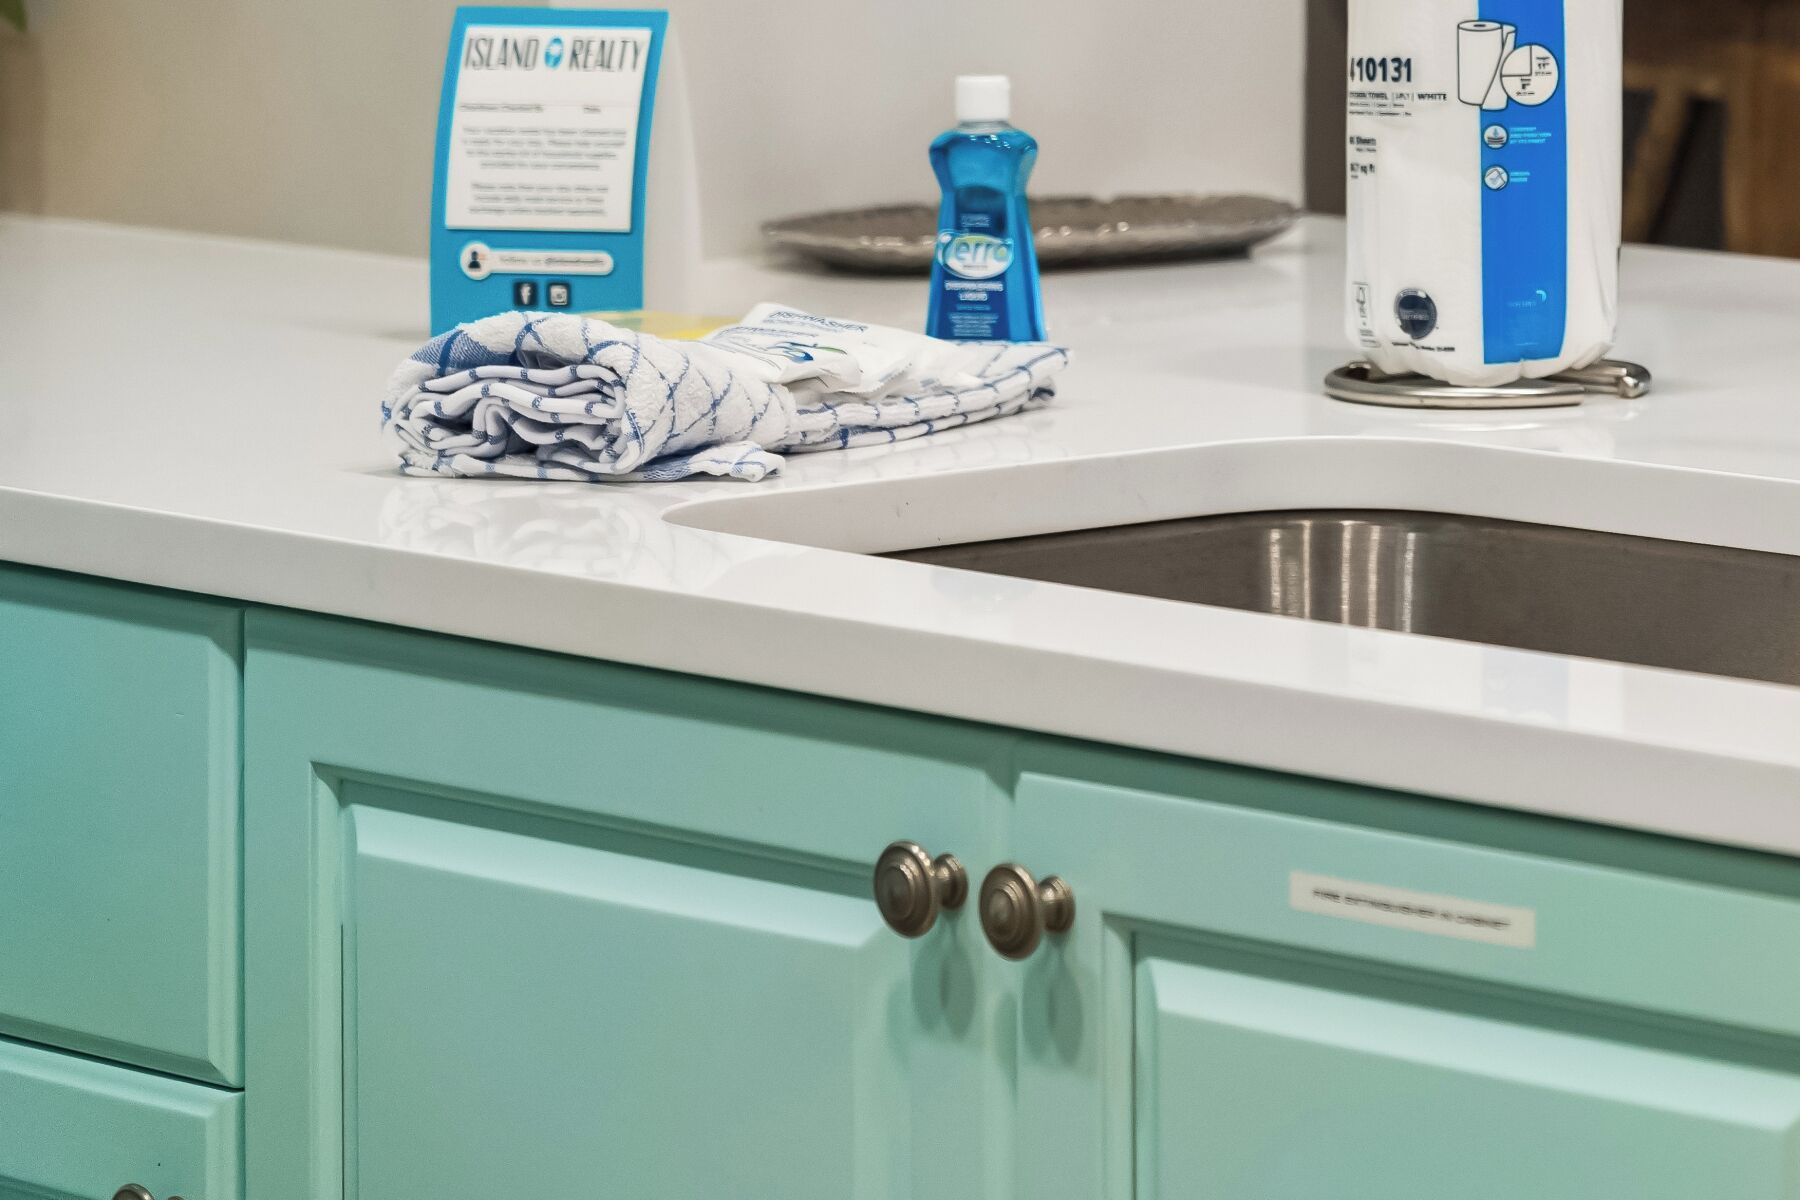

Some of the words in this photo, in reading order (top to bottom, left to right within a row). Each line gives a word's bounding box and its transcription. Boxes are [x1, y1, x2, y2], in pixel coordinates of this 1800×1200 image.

[464, 37, 540, 71] ISLAND
[568, 37, 642, 72] REALTY
[1417, 92, 1448, 102] WHITE
